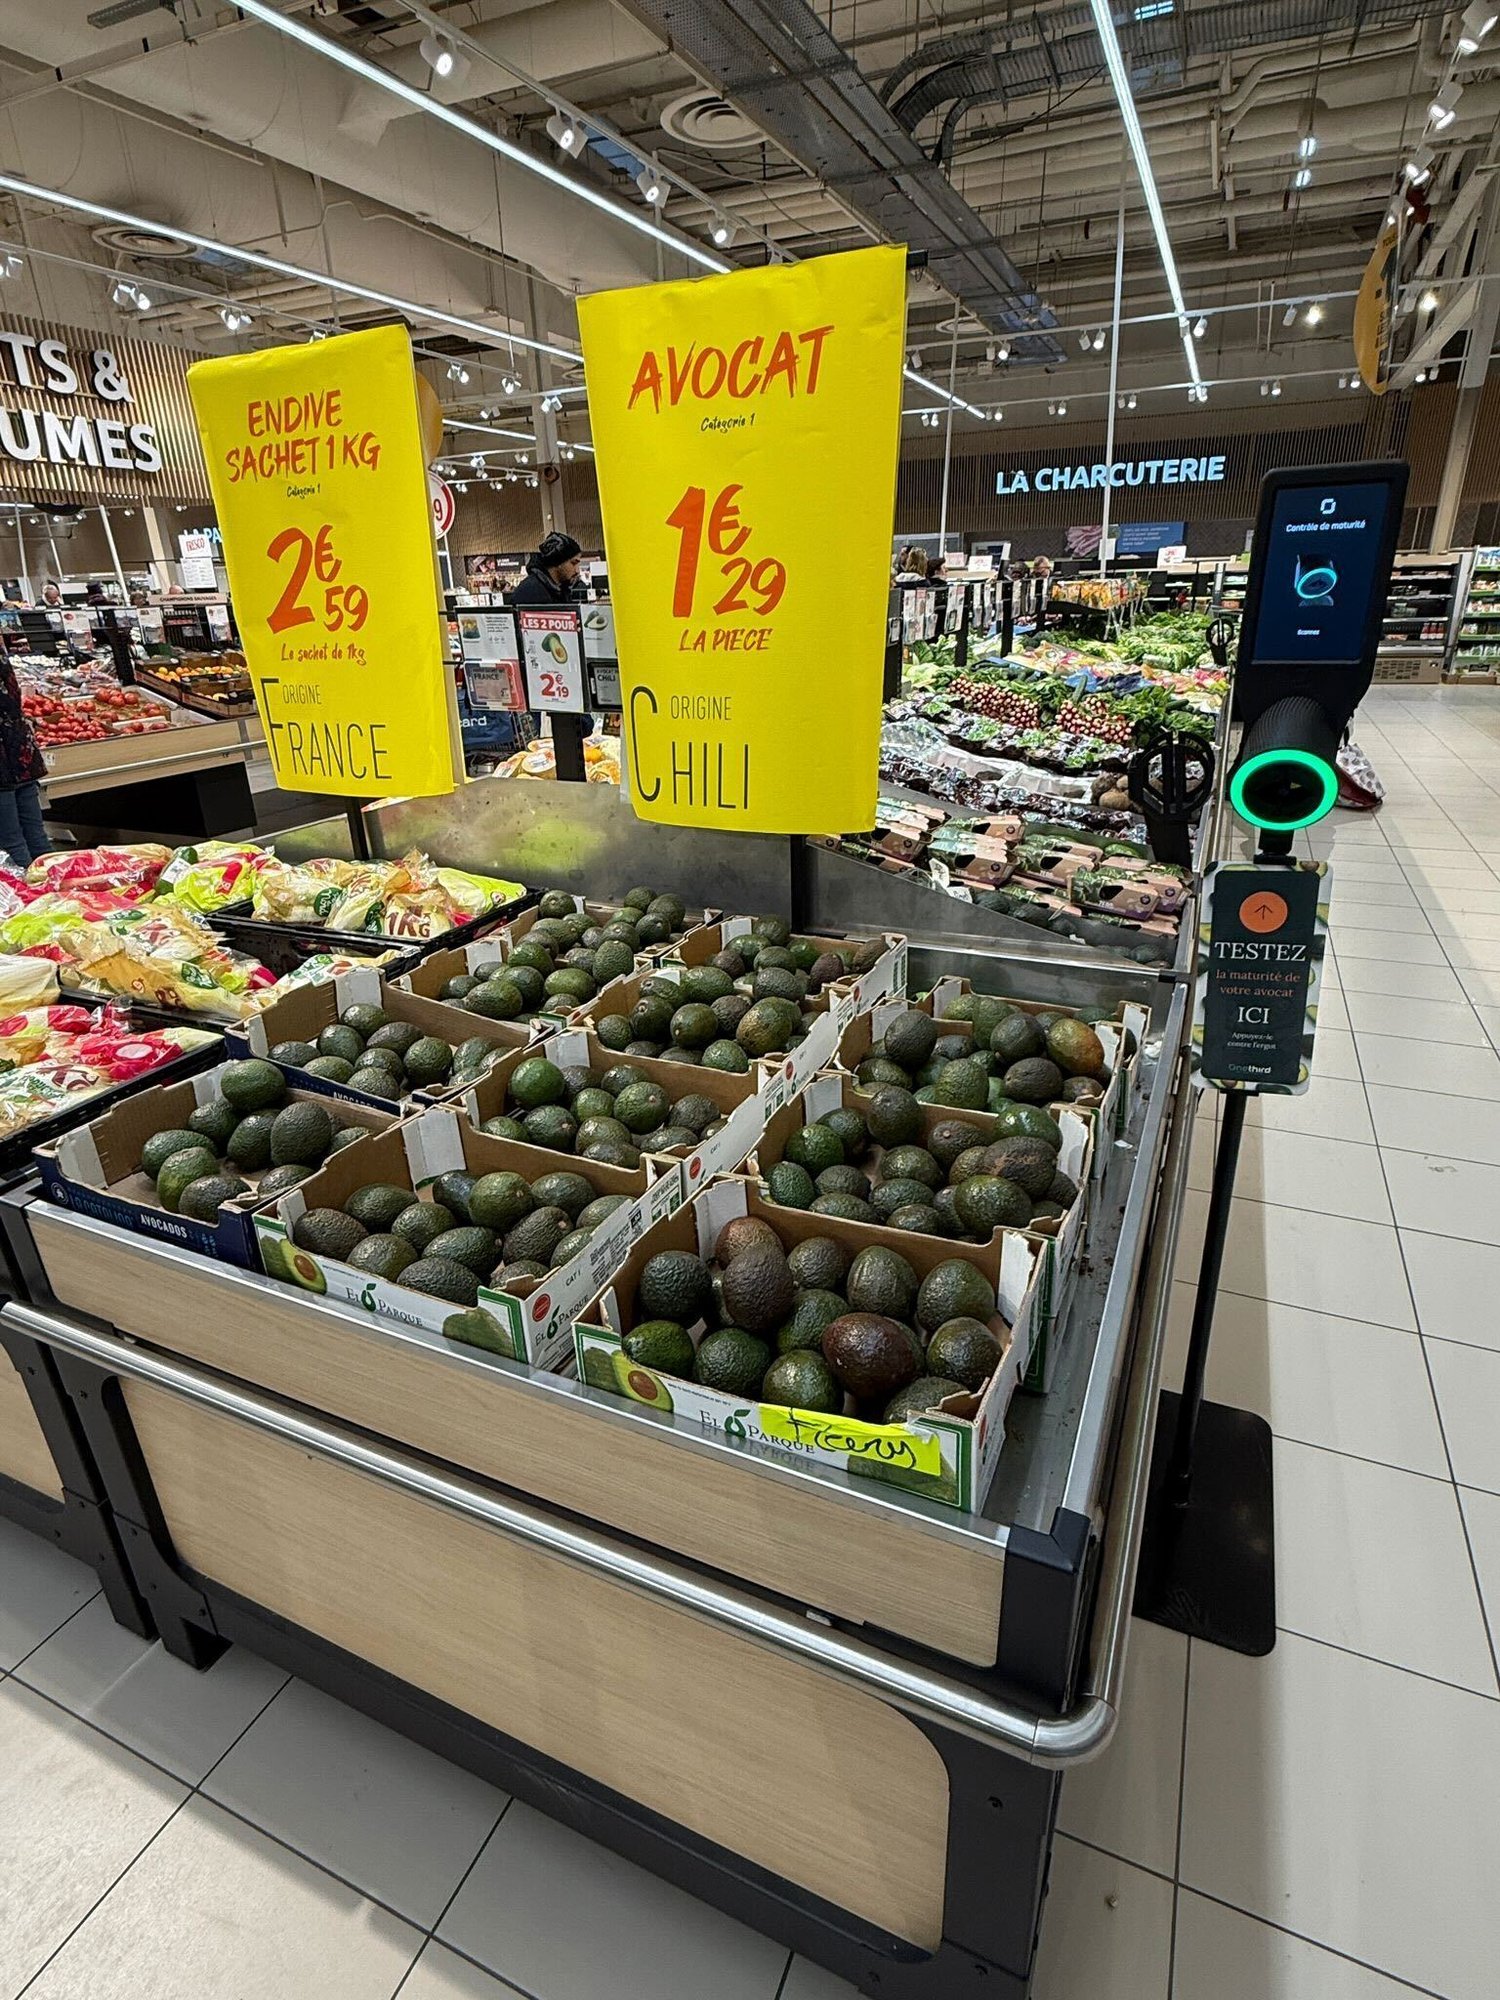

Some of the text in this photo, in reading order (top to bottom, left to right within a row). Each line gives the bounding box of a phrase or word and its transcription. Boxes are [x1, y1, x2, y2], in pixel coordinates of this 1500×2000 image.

[0, 331, 135, 403] TS &
[628, 325, 835, 414] AVOCAT
[248, 388, 342, 437] ENDIVE
[750, 413, 755, 426] 1
[226, 431, 381, 482] SACHET 1 KG
[996, 456, 1226, 494] LA CHARCUTERIE
[1320, 521, 1330, 531] de
[523, 618, 575, 630] LES 2 POUR
[281, 643, 294, 661] Le
[298, 643, 328, 662] sachet
[331, 643, 343, 660] de
[679, 628, 773, 652] LA PIECE
[282, 684, 322, 705] ORIGINE
[670, 695, 732, 721] ORIGINE
[1215, 942, 1307, 962] TESTEZ
[1216, 968, 1301, 983] la maturité de
[1220, 985, 1294, 998] votre avocat
[1237, 1007, 1270, 1024] ICI
[140, 1213, 188, 1239] AVOCADOS
[378, 1299, 423, 1327] PARQUE
[558, 1294, 589, 1326] PARQUE
[749, 1425, 815, 1455] PARQUE
